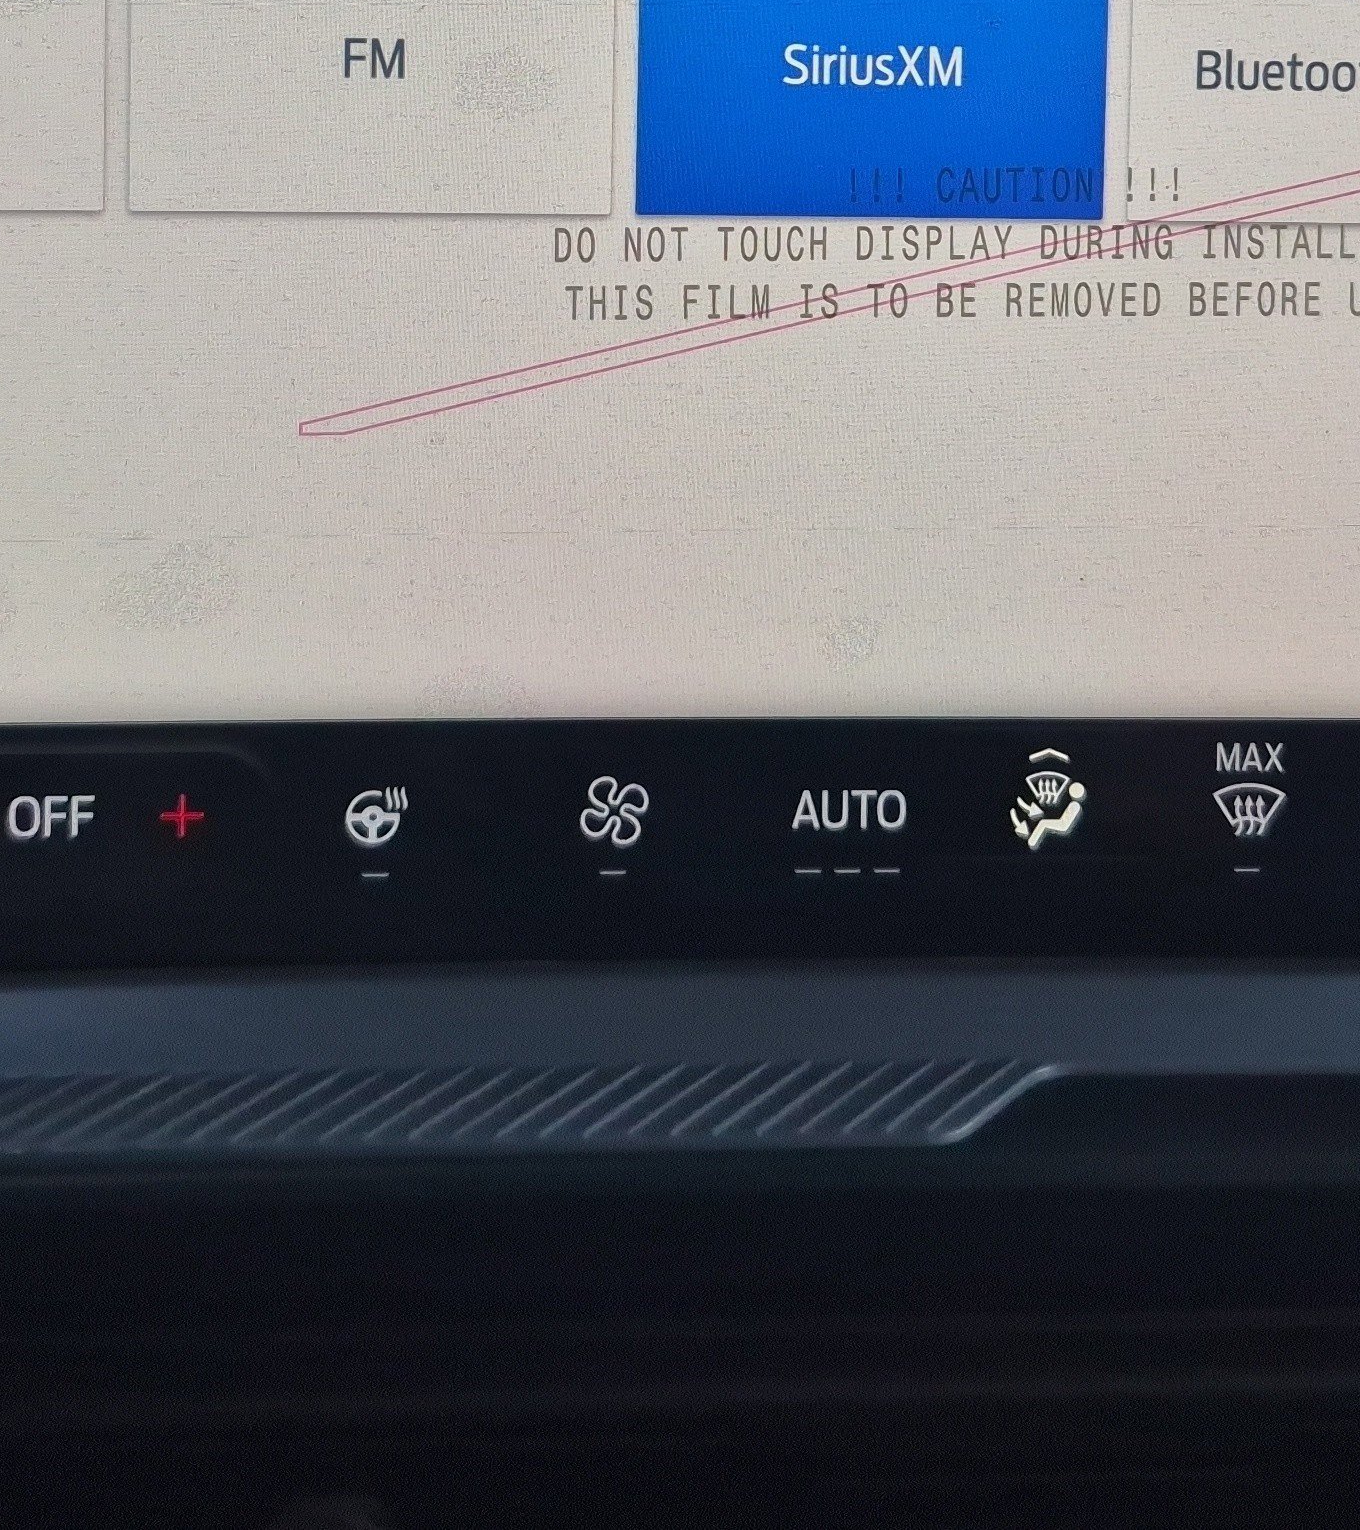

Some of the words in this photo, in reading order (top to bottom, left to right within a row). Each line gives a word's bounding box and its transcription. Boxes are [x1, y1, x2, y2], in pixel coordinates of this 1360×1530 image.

[342, 38, 406, 79] FM
[782, 43, 964, 88] SiriusXM
[937, 167, 1095, 204] CAUTION
[554, 227, 597, 263] DO
[624, 227, 688, 263] NOT
[718, 227, 829, 263] TOUCH
[856, 226, 1012, 262] DISPLAY
[1041, 225, 1174, 261] DURING
[566, 285, 653, 320] THIS
[682, 285, 771, 320] FILM
[800, 285, 839, 319] IS
[867, 284, 909, 319] TO
[937, 284, 976, 318] BE
[1006, 283, 1161, 317] REMOVED
[1189, 282, 1321, 317] BEFORE
[1216, 743, 1283, 773] MAX
[7, 796, 95, 840] OFF
[792, 789, 907, 830] AUTO
